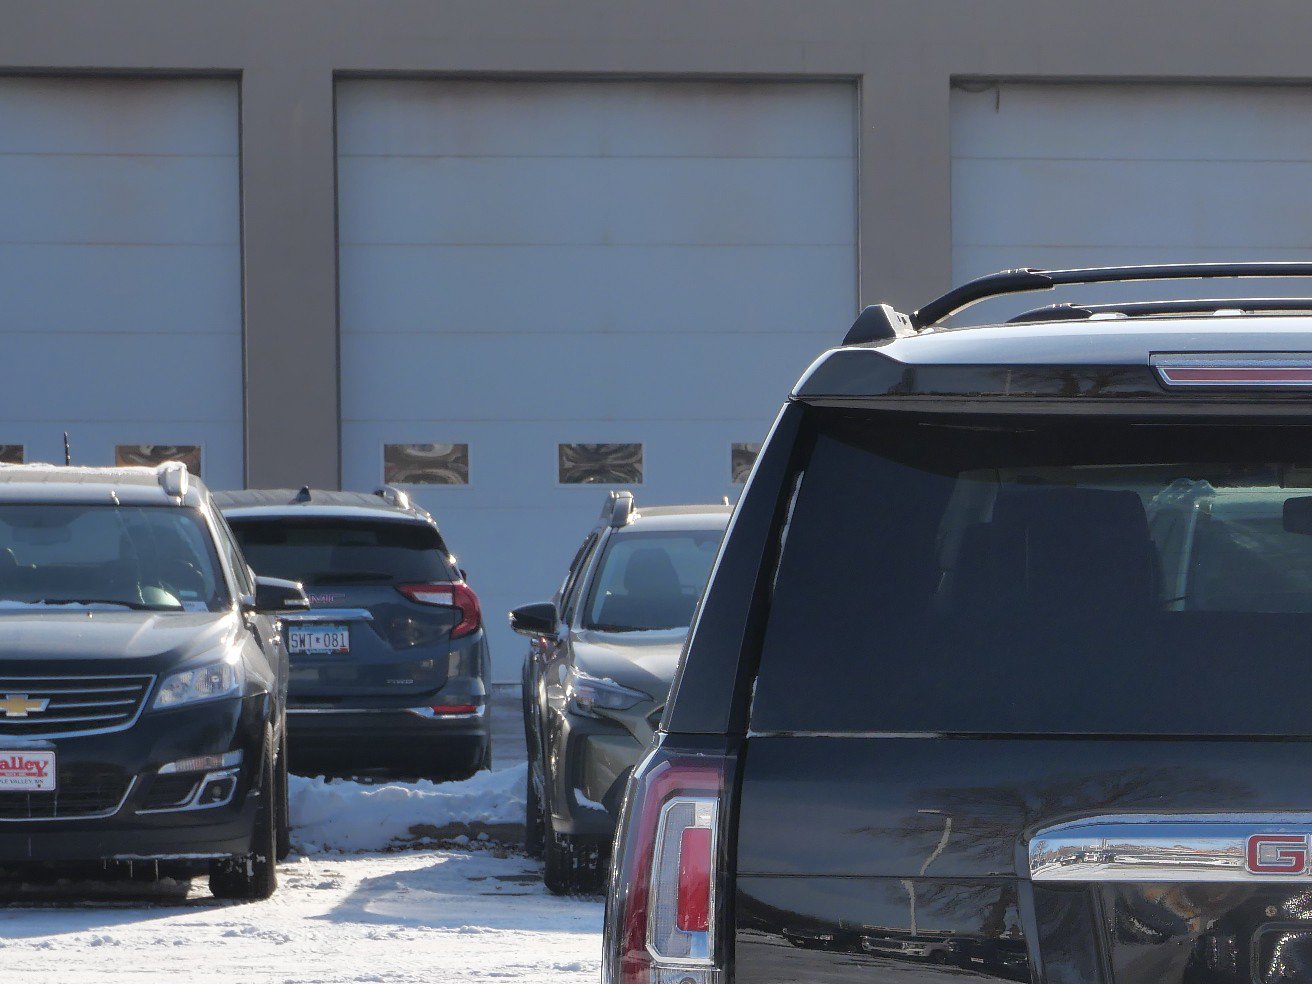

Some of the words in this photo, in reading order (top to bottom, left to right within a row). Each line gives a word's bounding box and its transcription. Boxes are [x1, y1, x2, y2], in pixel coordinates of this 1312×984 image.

[308, 594, 346, 604] MC
[291, 633, 313, 648] SWT
[323, 633, 347, 648] 081
[0, 756, 48, 777] alley
